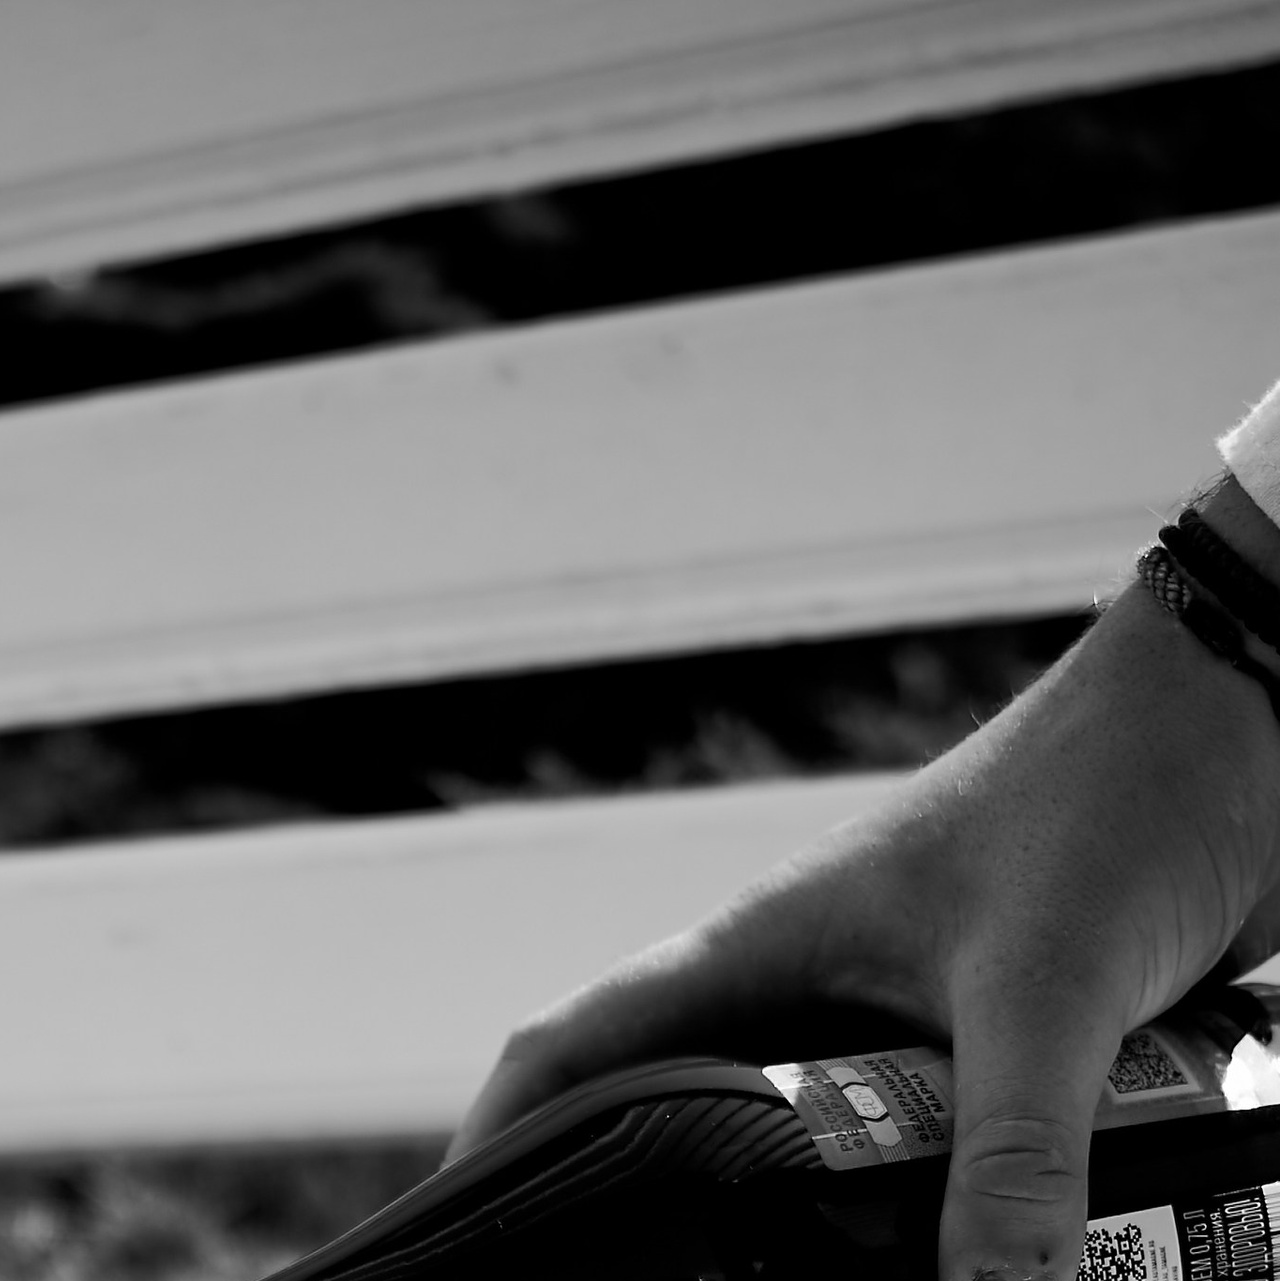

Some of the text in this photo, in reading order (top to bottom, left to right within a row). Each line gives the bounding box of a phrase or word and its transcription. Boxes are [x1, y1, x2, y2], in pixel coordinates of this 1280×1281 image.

[803, 1069, 865, 1149] ФЕДЕРАЦИЯ
[864, 1059, 931, 1143] ФЕДЕРАЛЬНАЯ
[877, 1057, 945, 1141] СПЕЦИАЛЬНАЯ
[910, 1072, 945, 1113] МАРКА
[1182, 1208, 1206, 1220] Л
[1187, 1222, 1213, 1255] 0,75
[1209, 1207, 1231, 1277] хранения.
[1223, 1197, 1273, 1277] ЗДОРОВЬЮ!
